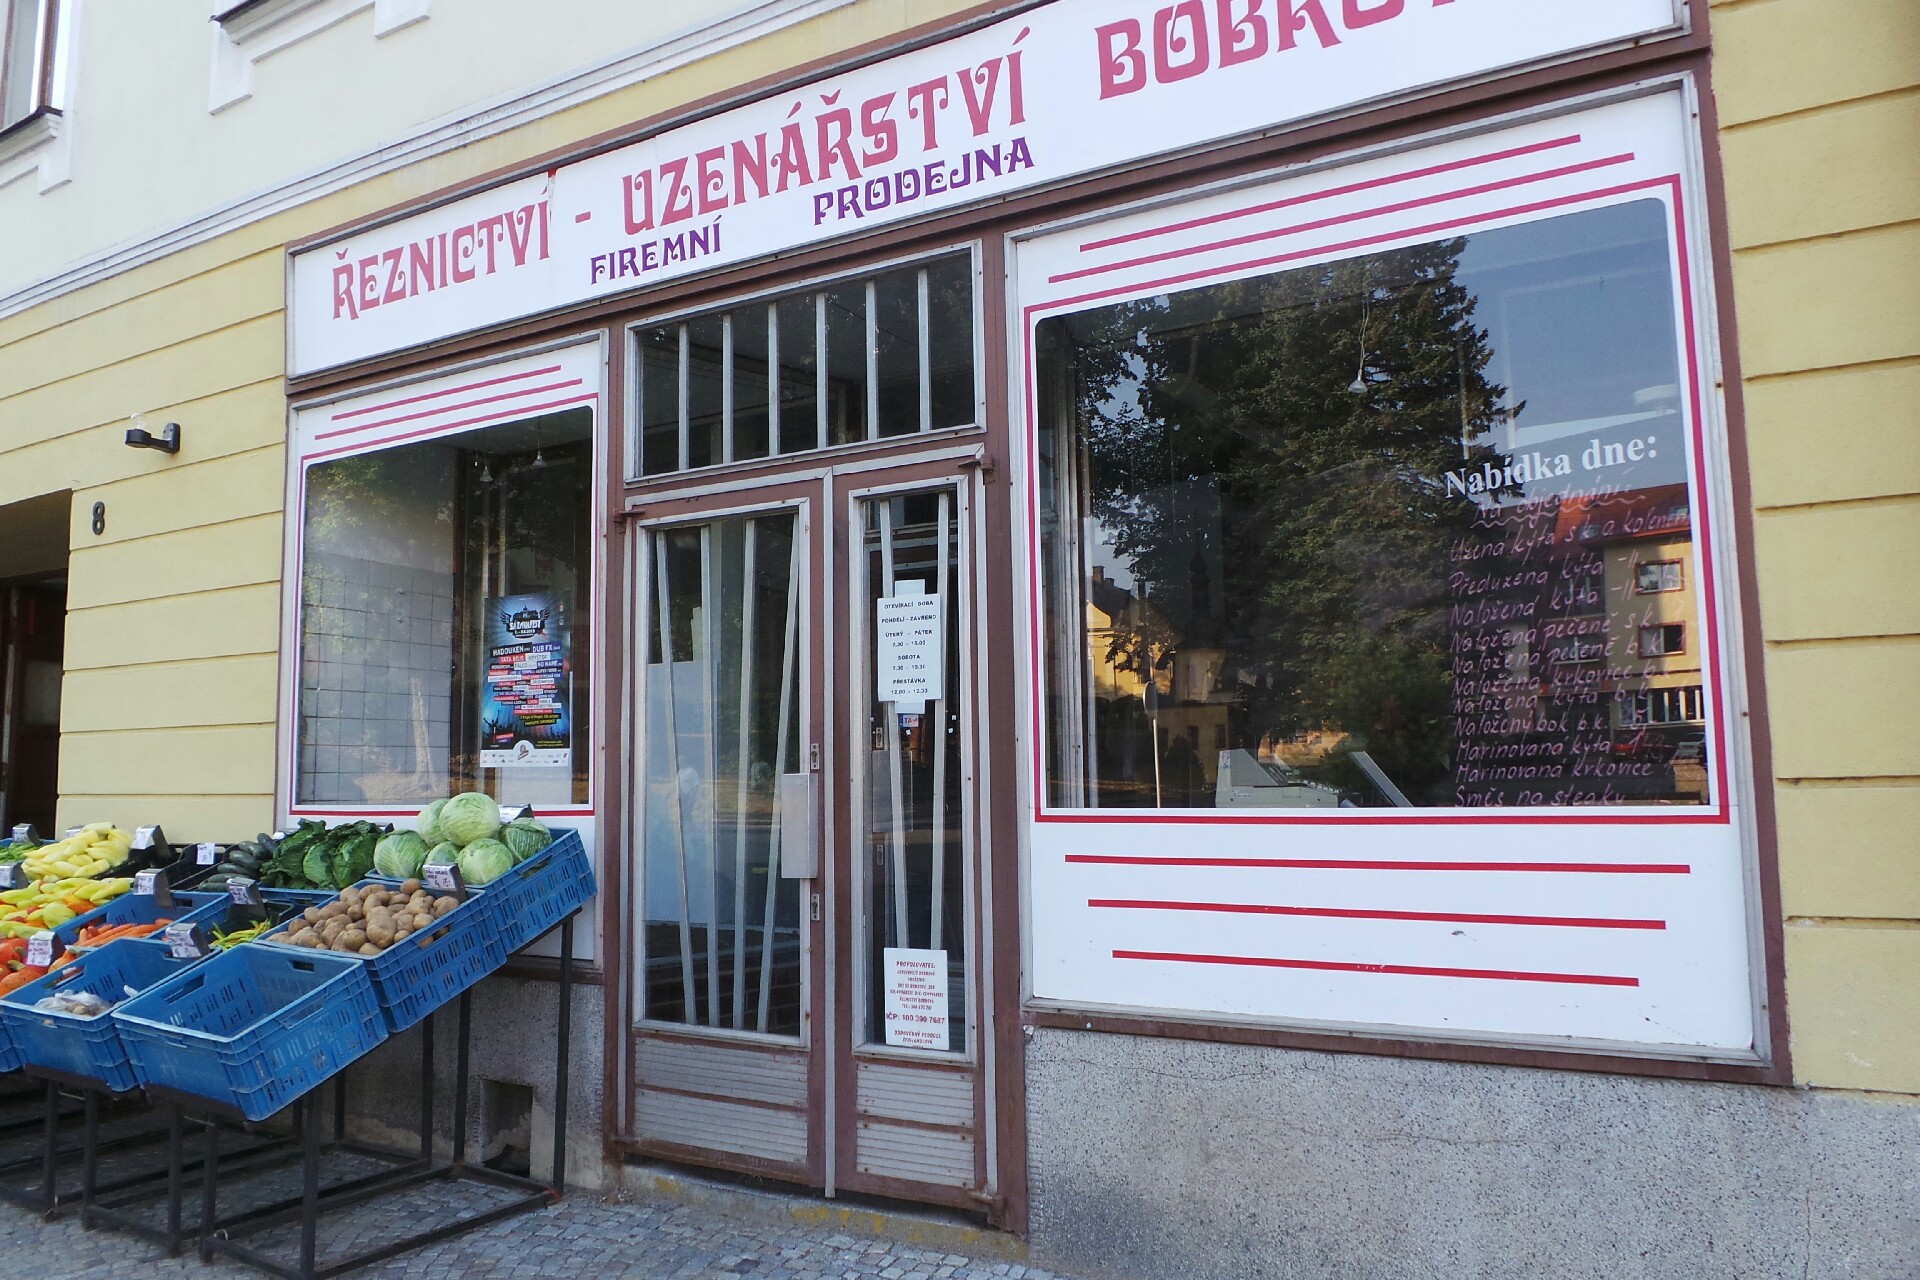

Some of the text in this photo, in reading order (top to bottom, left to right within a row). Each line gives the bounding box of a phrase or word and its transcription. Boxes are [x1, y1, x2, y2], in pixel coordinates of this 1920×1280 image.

[332, 186, 552, 321] ŘEZNICTVÍ
[622, 26, 1030, 237] UZENÁŘSTVÍ
[1095, 0, 1453, 101] BOBR
[590, 137, 1035, 285] FIREMNÍ PRODEJNA
[1444, 434, 1658, 499] Nabídka dne:
[92, 502, 106, 535] 8
[1602, 519, 1616, 536] a
[1560, 552, 1604, 583] kýta
[884, 600, 914, 609] OTEVÍRACÍ
[1450, 595, 1540, 628] Naložená
[1450, 618, 1542, 653] Naložená
[1544, 611, 1618, 651] pečeně
[532, 645, 545, 653] DUB
[545, 644, 553, 652] FX
[1451, 645, 1542, 675] Naložená
[1547, 634, 1621, 675] pečeně
[892, 677, 926, 685] PŘESTÁVKA
[1452, 665, 1545, 698] Naložená
[1454, 690, 1544, 714] Naložená
[1553, 686, 1599, 716] kýta
[1454, 710, 1533, 745] Naložený
[1536, 711, 1568, 733] bok
[1456, 735, 1569, 762] Marinovaná
[1571, 733, 1611, 765] kýta
[1456, 757, 1653, 783] Marinovaná krkovice
[1455, 785, 1504, 807] Směs
[1517, 790, 1543, 806] na
